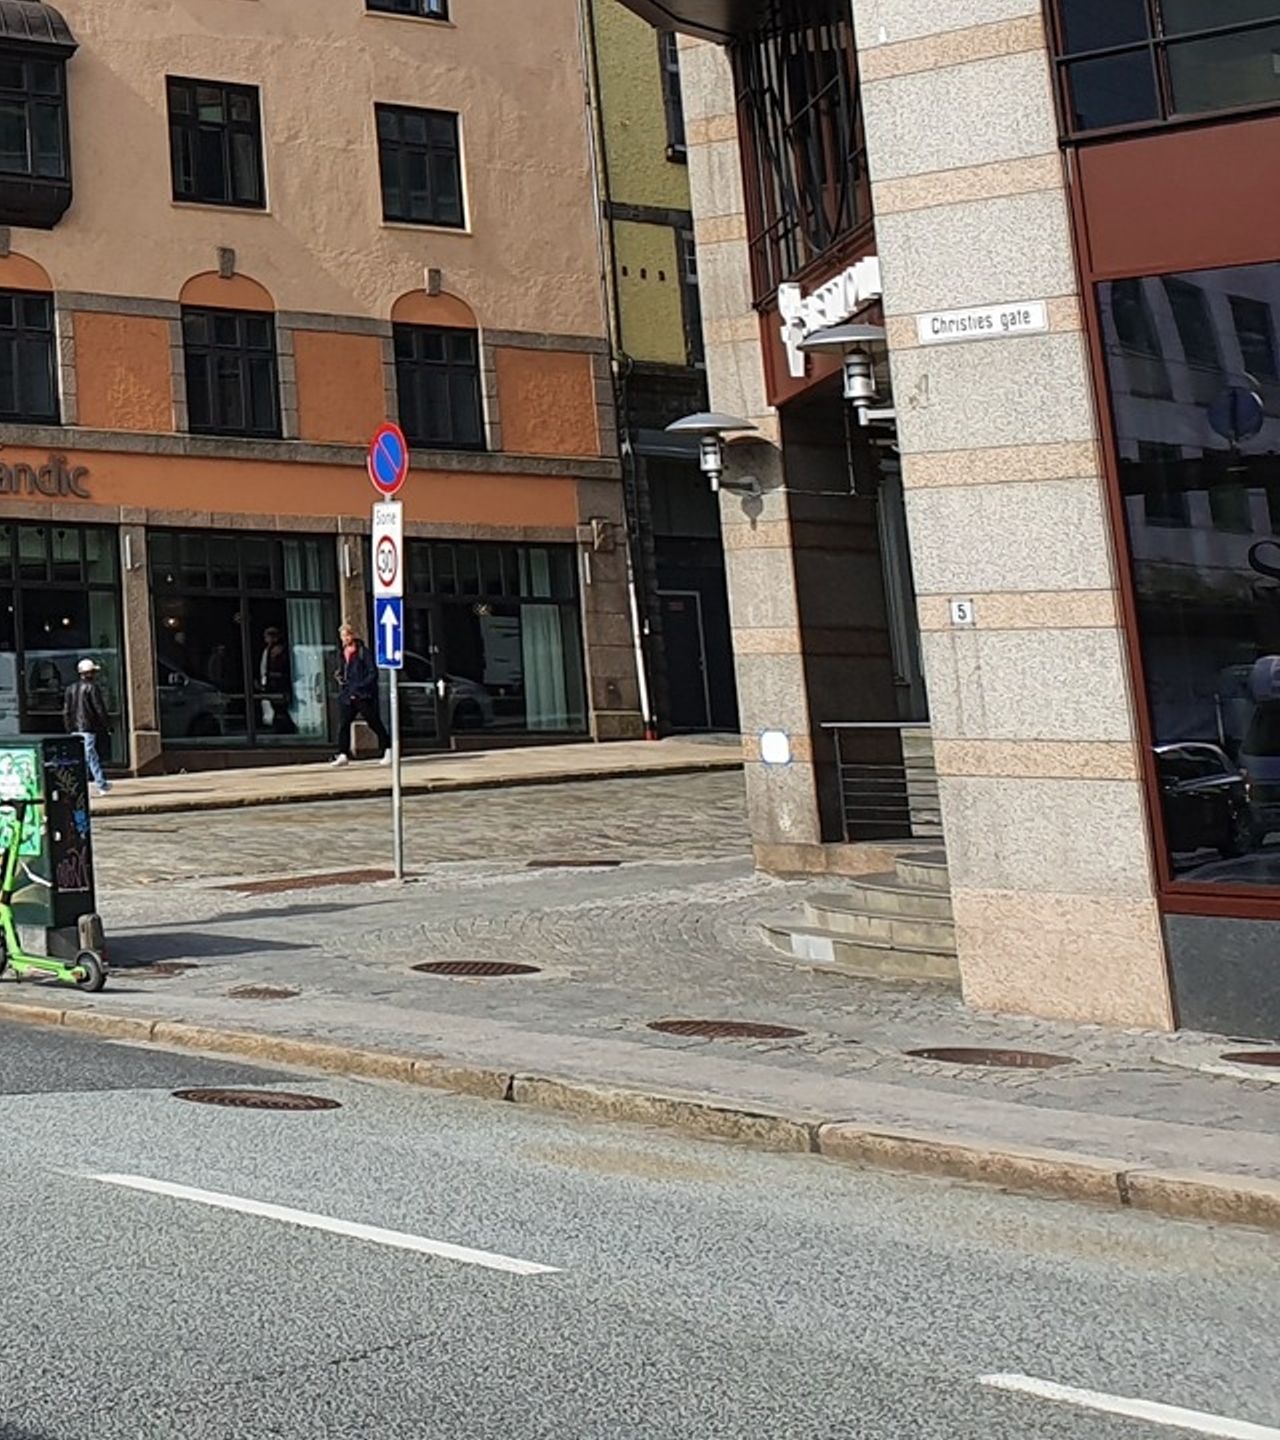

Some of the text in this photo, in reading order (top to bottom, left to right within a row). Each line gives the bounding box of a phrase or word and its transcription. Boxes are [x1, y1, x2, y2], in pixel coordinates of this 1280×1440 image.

[931, 310, 1031, 334] Christies gate
[376, 509, 396, 526] Sone
[378, 549, 393, 574] 30
[957, 603, 967, 621] 5
